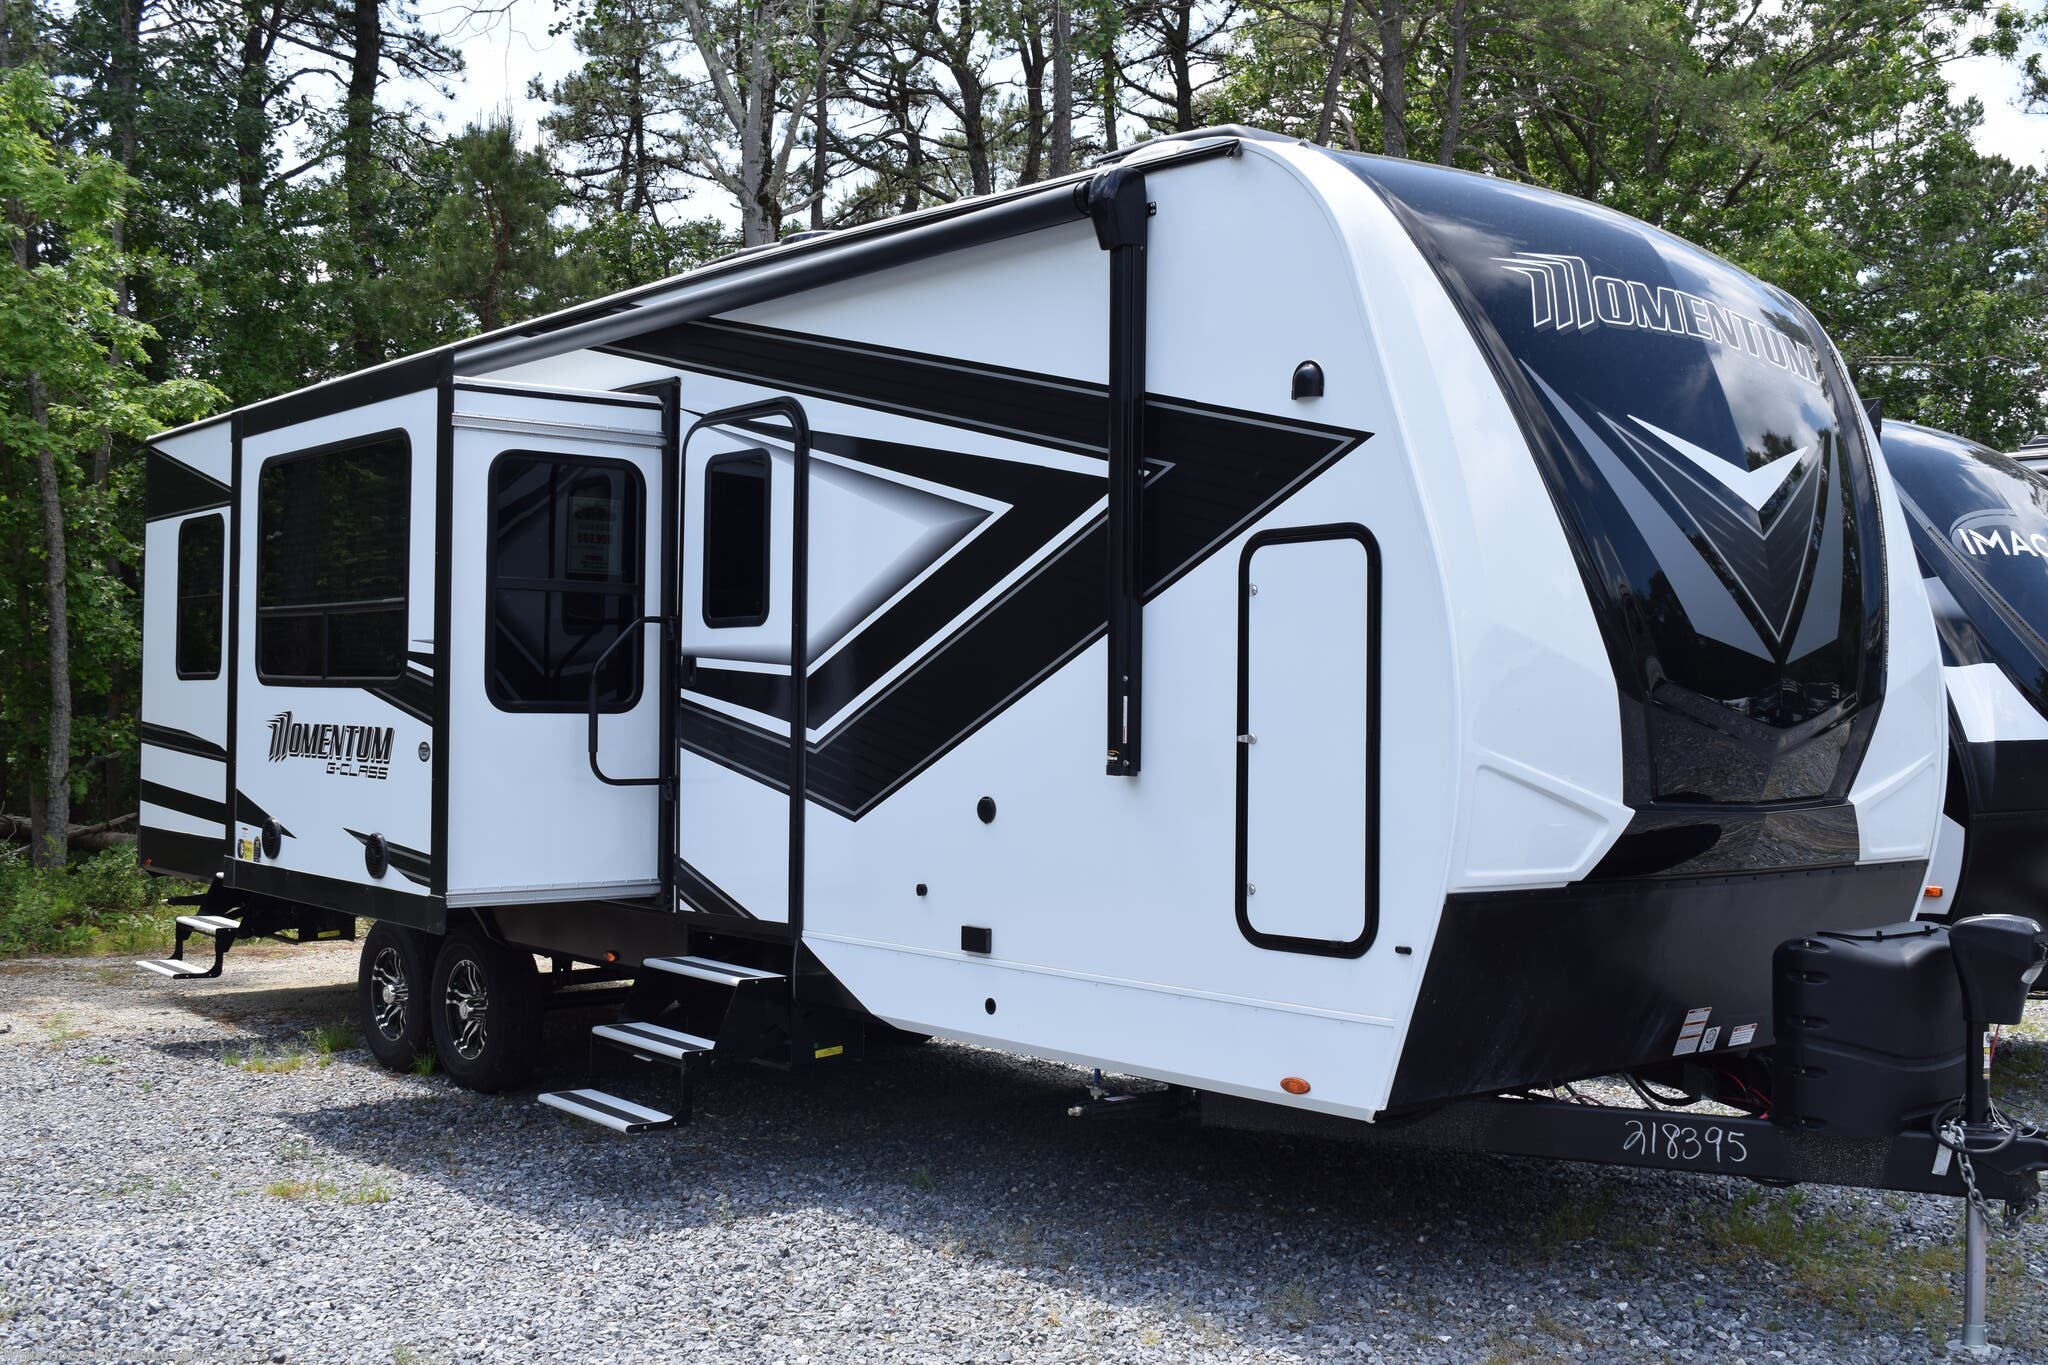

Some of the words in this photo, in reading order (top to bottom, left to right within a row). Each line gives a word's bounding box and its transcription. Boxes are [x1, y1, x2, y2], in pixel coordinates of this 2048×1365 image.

[1488, 251, 1820, 386] MOMENTUM
[265, 711, 396, 764] MOMENTUM
[326, 762, 389, 780] G-CLASS
[1623, 1120, 1748, 1163] 218395
